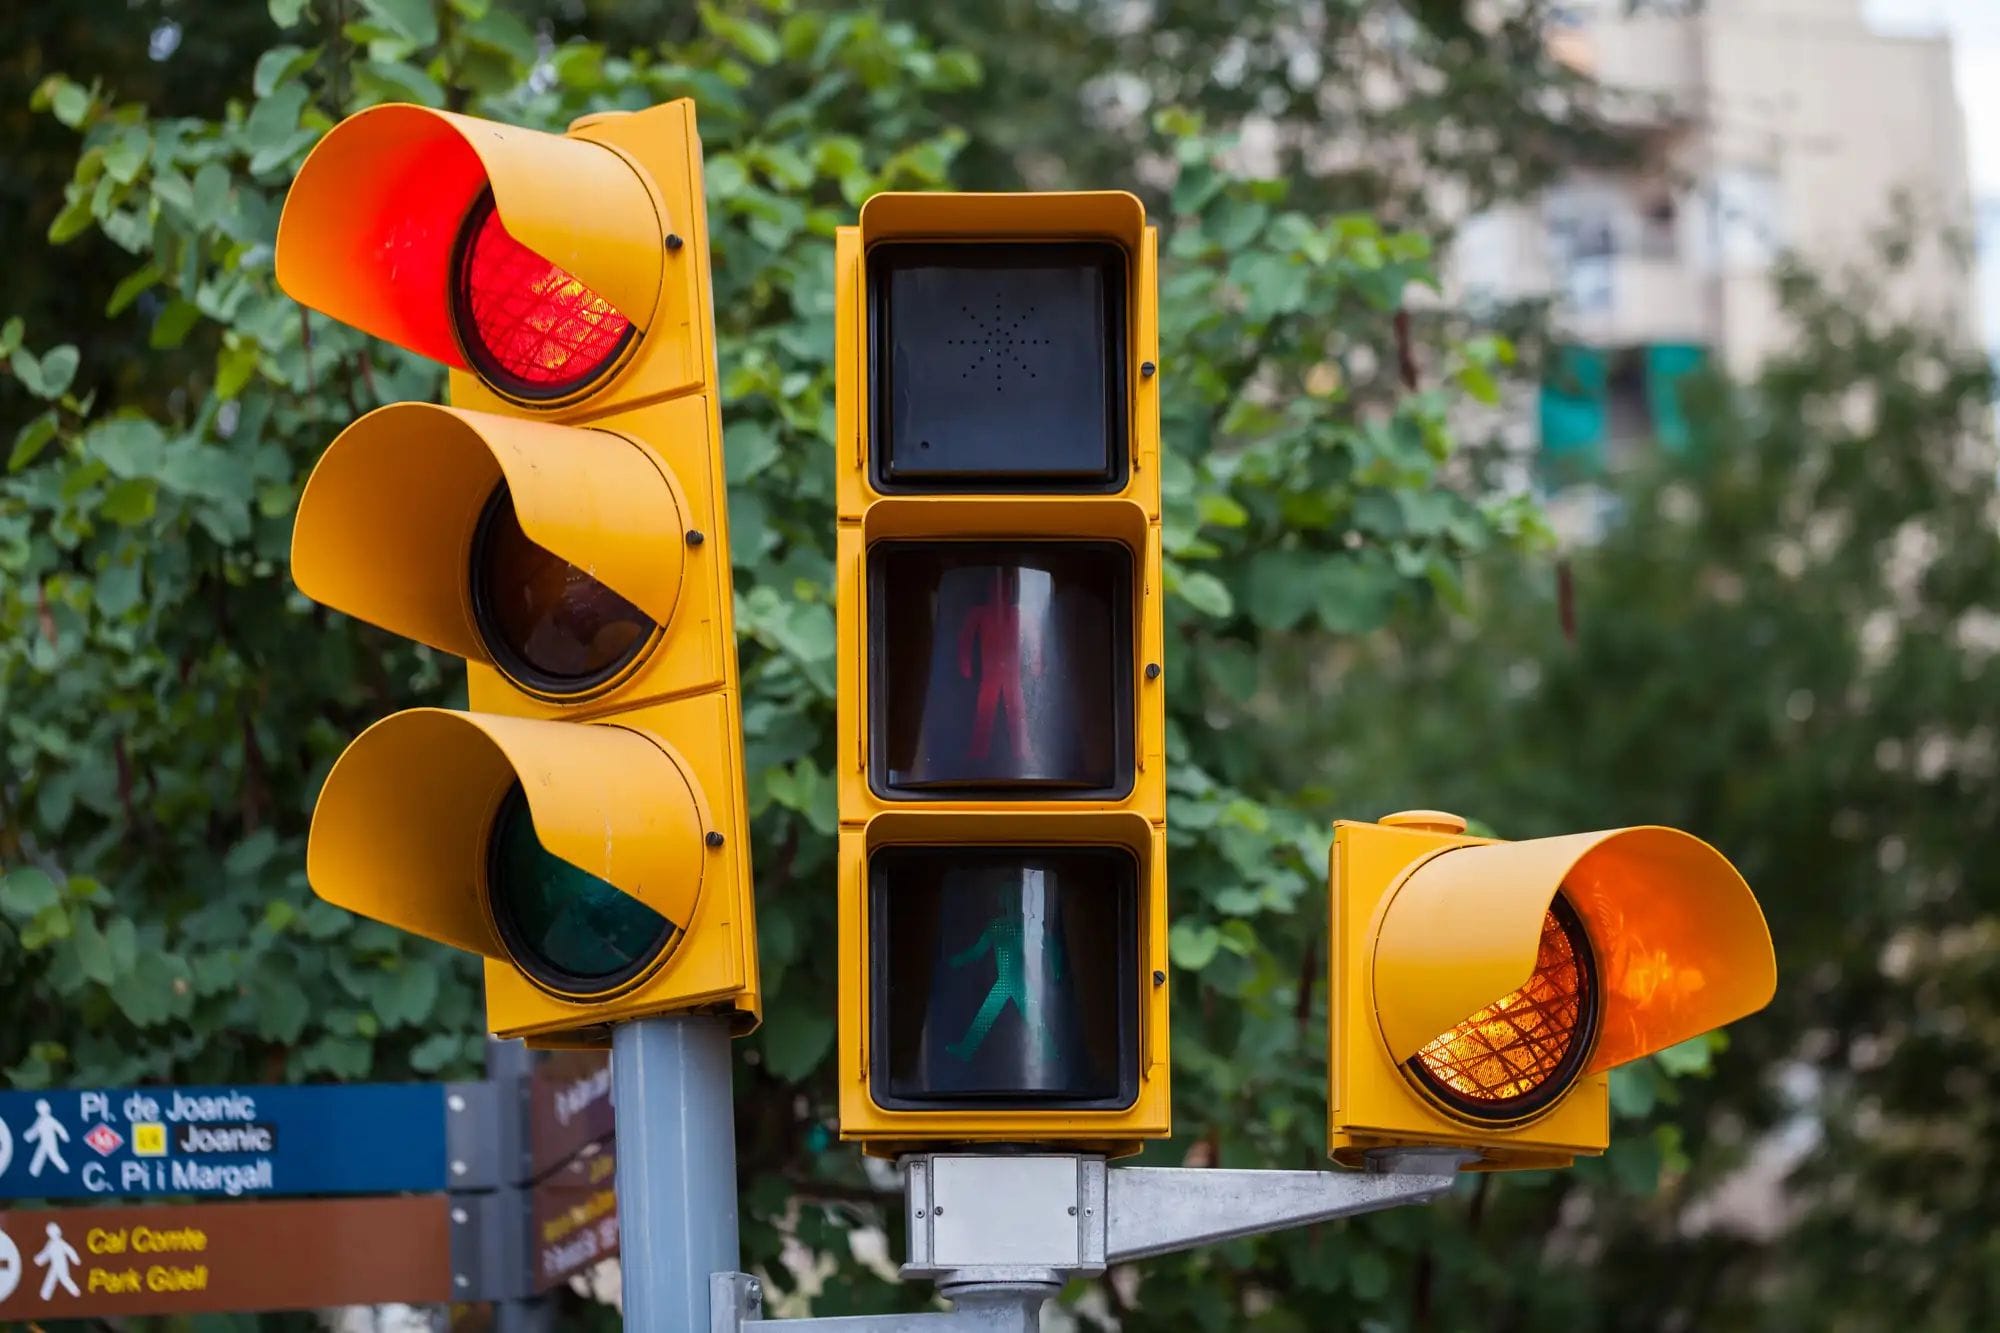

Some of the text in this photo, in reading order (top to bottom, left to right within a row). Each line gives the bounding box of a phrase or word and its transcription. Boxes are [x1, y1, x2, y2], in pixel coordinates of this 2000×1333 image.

[80, 1090, 256, 1122] Pl. de Joanic
[180, 1124, 272, 1152] Joanic
[82, 1158, 273, 1196] C. Pi i Margall
[88, 1267, 142, 1293] Park
